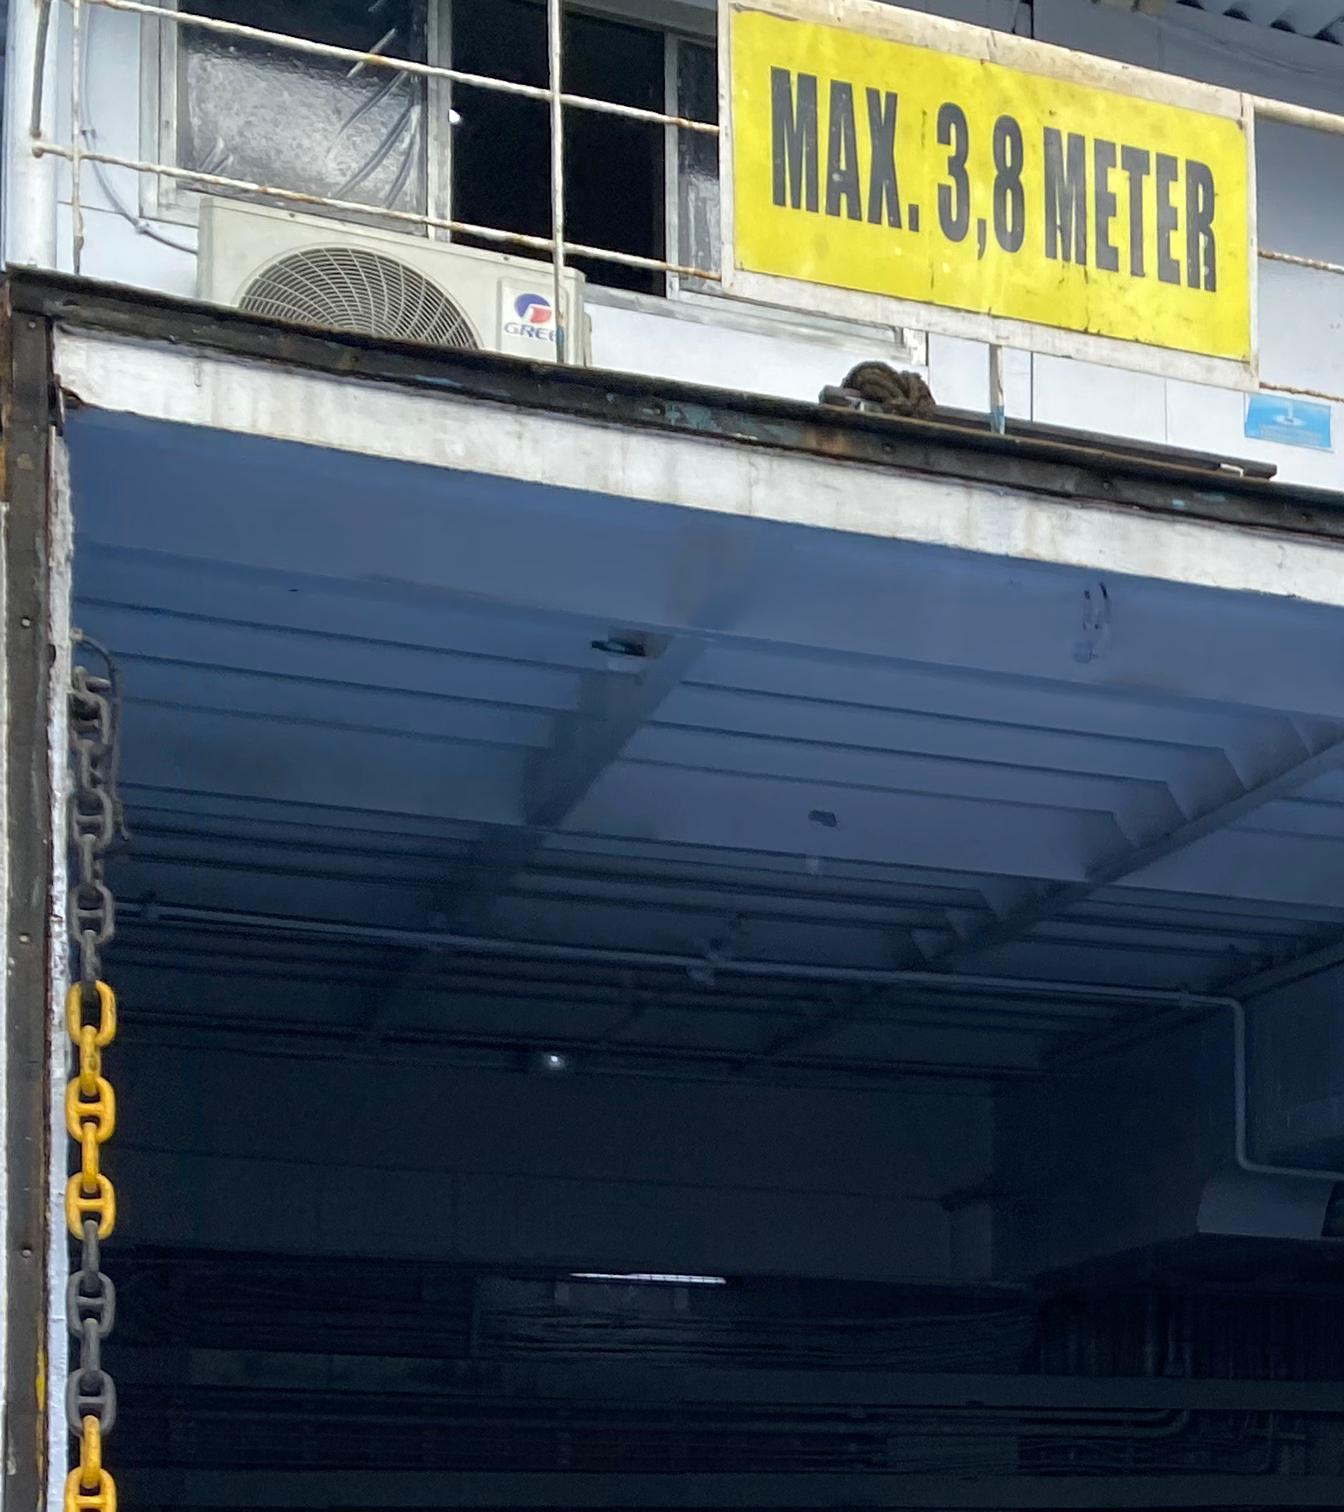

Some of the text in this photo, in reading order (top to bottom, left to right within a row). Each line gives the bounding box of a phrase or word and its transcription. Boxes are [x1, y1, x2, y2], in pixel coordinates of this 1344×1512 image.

[770, 65, 1217, 293] MAX. 3,8 METER
